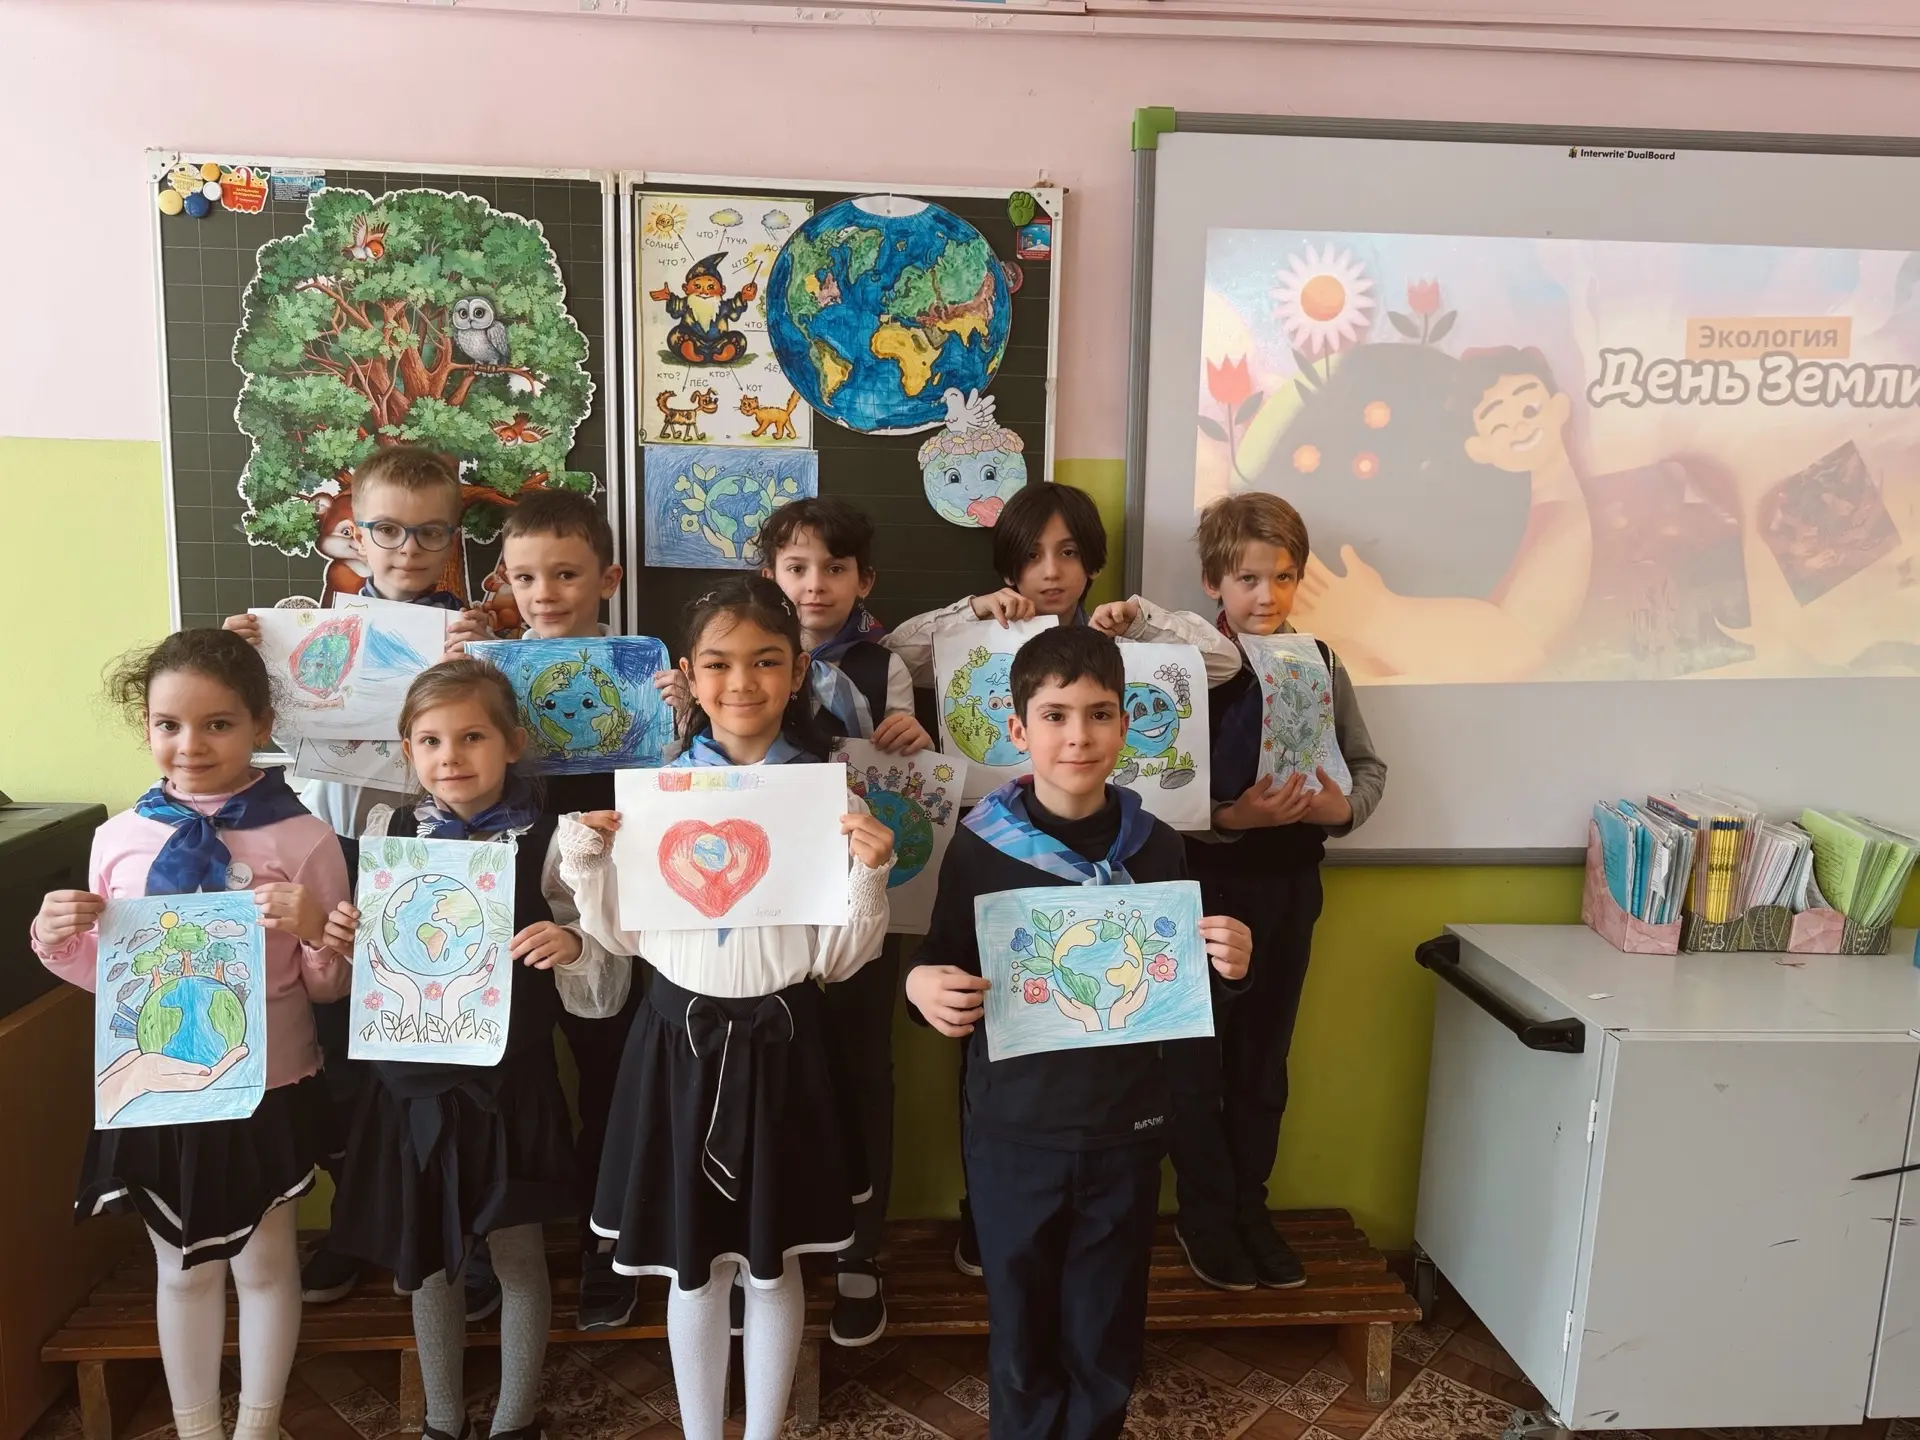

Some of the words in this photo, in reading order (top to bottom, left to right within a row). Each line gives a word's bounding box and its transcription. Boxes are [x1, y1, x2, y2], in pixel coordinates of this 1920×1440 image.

[1580, 149, 1625, 159] Interwrite
[1627, 150, 1676, 160] DualBoard
[696, 229, 719, 239] ЧТО?
[645, 238, 680, 251] СОЛНЦЕ
[726, 236, 748, 245] ТУЧА
[732, 251, 754, 269] ЧТО?
[1699, 326, 1838, 348] Экология
[656, 371, 681, 381] КТО?
[1586, 347, 1751, 409] День
[746, 383, 763, 392] КОТ
